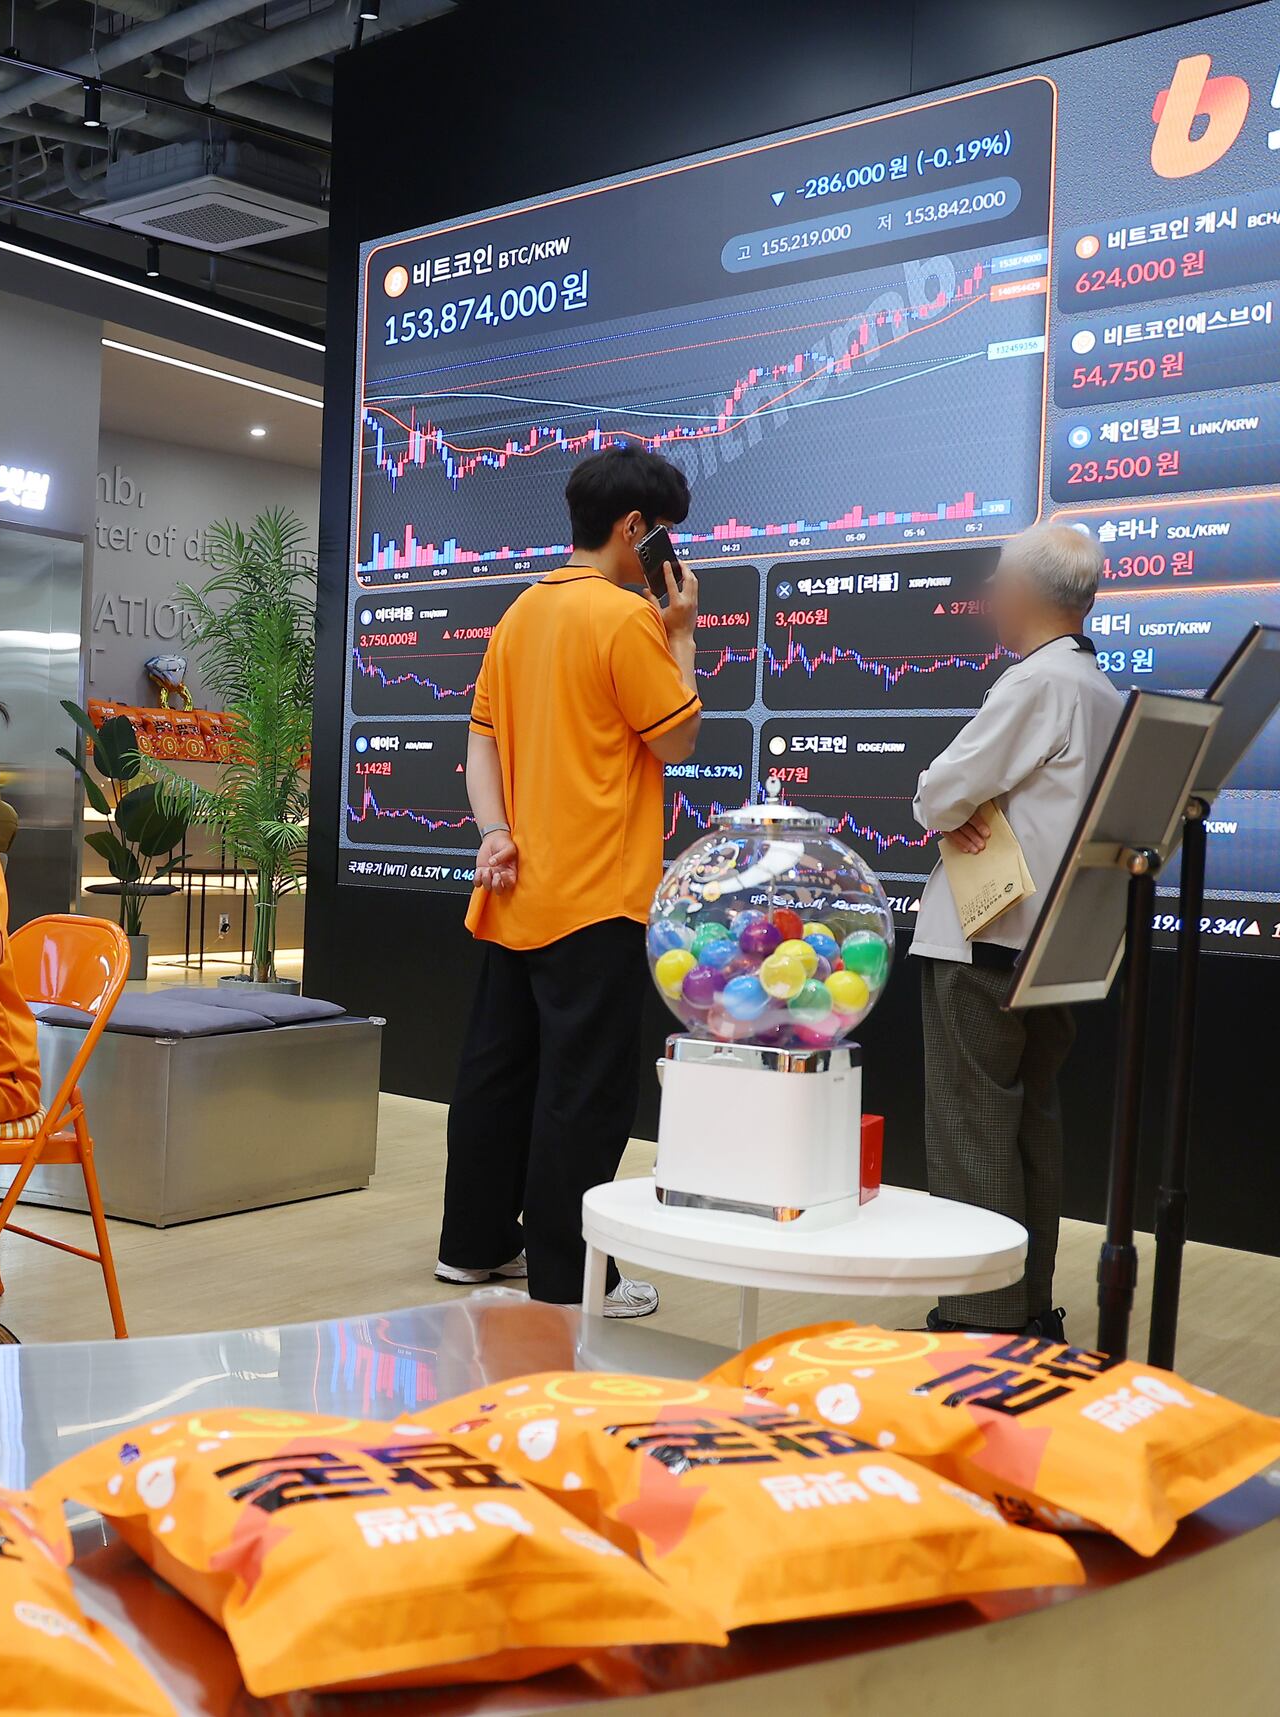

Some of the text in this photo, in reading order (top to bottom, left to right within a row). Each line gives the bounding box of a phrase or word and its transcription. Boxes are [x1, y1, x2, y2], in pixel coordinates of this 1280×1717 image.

[916, 129, 1012, 176] (-0.19%)
[737, 190, 1007, 261] 고 155,219,000 저 153,842,000
[1107, 217, 1189, 250] 비트코인
[1195, 206, 1238, 236] 캐시
[412, 236, 571, 288] 비트코인 BTC/KRW
[1075, 256, 1177, 294] 624,000
[1103, 301, 1273, 347] 비트코인에스브이
[1071, 358, 1156, 390] 54,750
[1099, 415, 1260, 444] 체인링크 LINK/KRW
[1067, 455, 1152, 485] 23,500
[146, 524, 178, 558] of
[721, 543, 741, 553] 04-23
[845, 532, 867, 543] 05-09
[903, 528, 926, 538] 05-16
[1098, 516, 1231, 543] 솔라나 SOL/KRW
[374, 605, 415, 623] 이더리움
[775, 608, 829, 628] 3,406원
[1091, 613, 1212, 637] 테더 USDT/KRW
[359, 631, 418, 648] 3,750,000원
[1131, 648, 1155, 674] 원
[370, 736, 401, 751] 에이다
[790, 735, 848, 754] 도지코인
[355, 760, 392, 776] 1,142원
[1203, 820, 1239, 835] KRW
[347, 861, 382, 877] 국제유가
[382, 863, 408, 878] [WTI]
